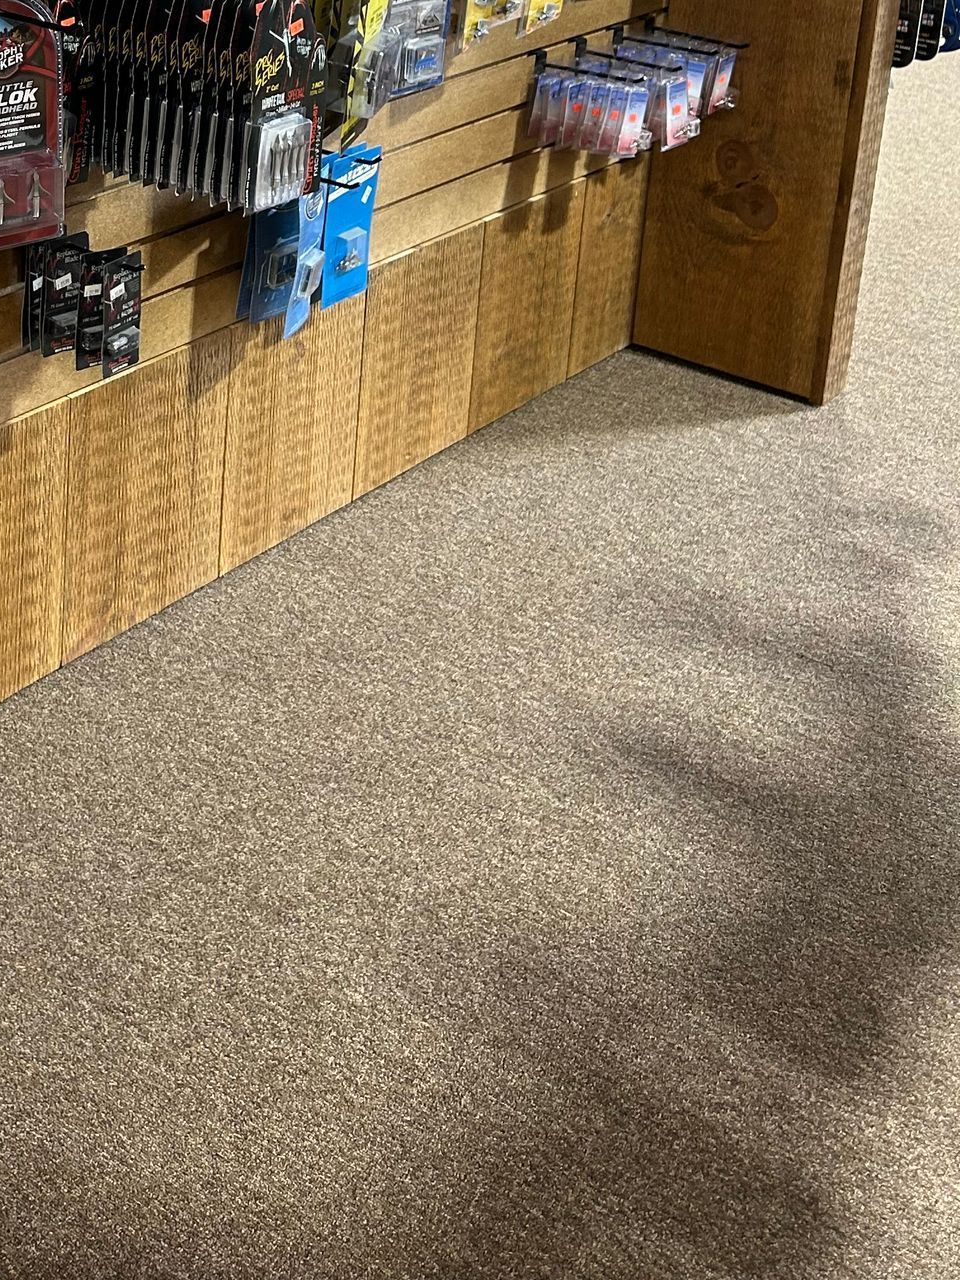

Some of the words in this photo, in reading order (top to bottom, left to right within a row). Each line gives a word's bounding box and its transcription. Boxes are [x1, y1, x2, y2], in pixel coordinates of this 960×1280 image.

[255, 48, 274, 73] PRO
[255, 51, 286, 96] SERIES
[286, 87, 305, 102] SPECIAL
